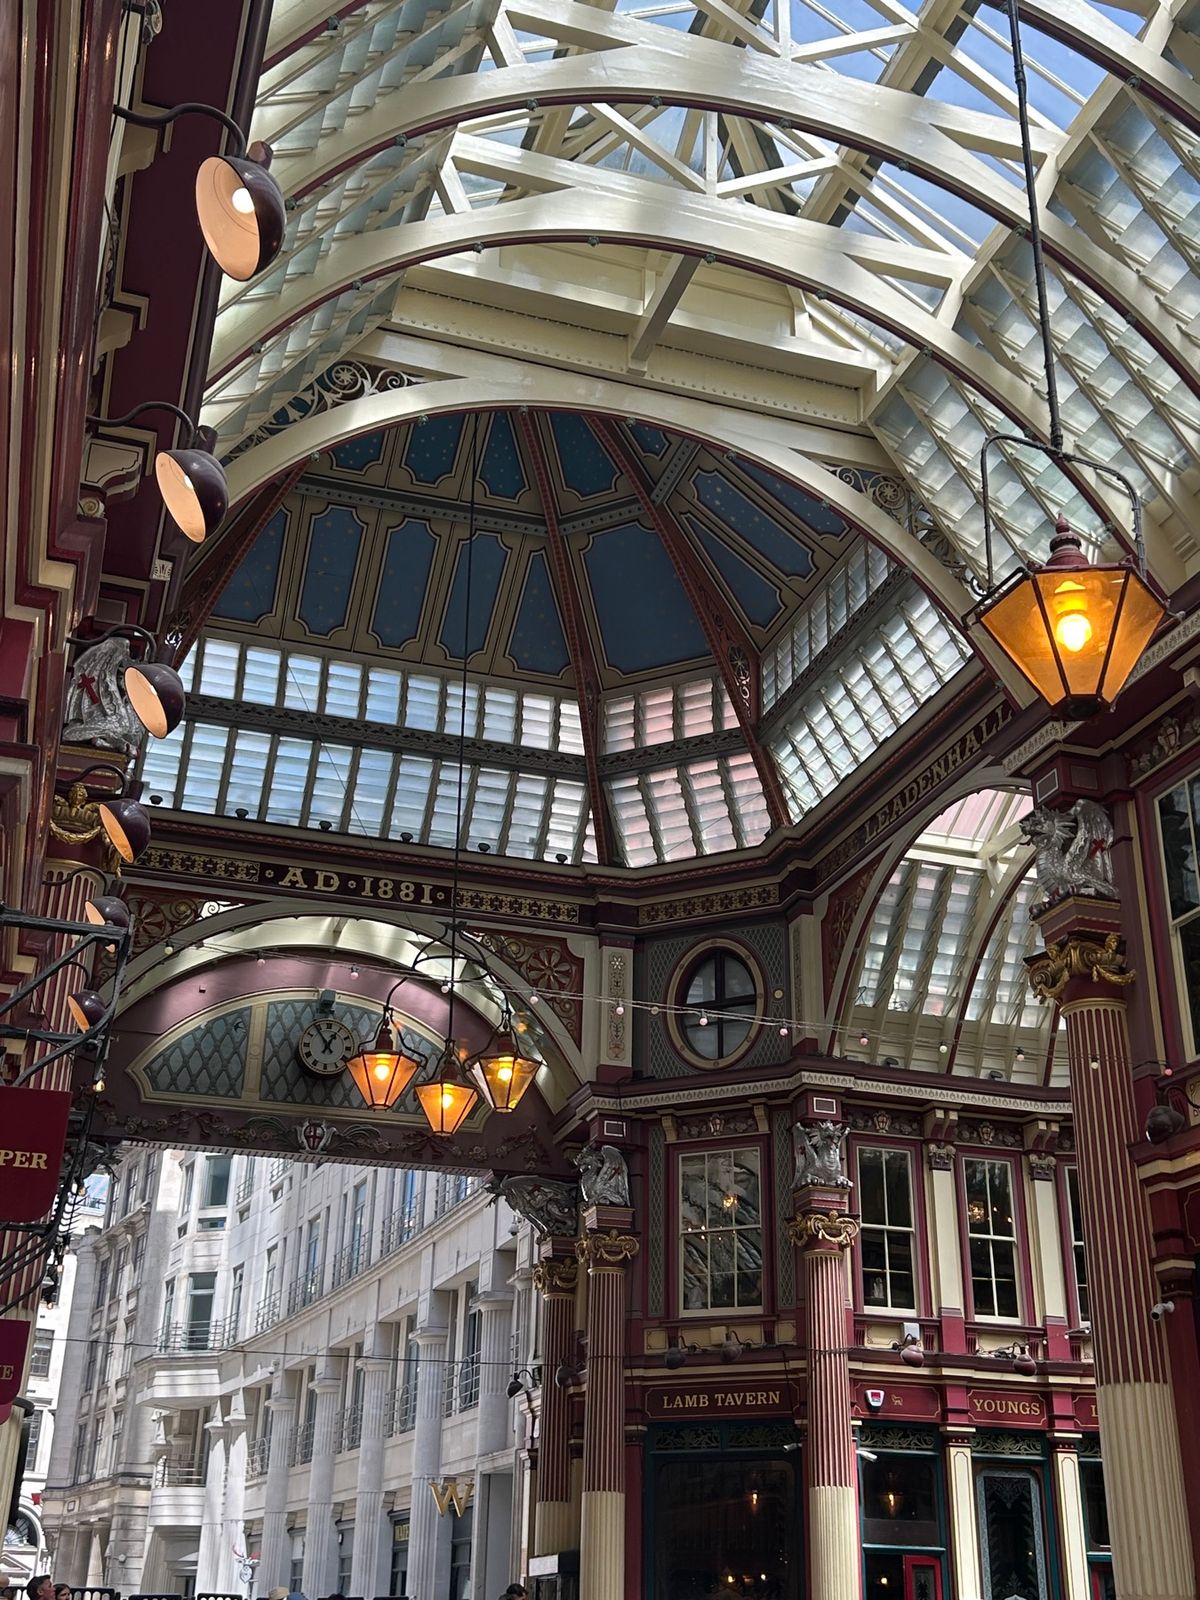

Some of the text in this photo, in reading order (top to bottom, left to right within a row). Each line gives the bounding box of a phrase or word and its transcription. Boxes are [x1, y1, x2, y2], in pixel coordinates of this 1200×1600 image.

[864, 702, 1013, 844] LEADENHALL
[361, 877, 434, 904] 1881
[663, 1391, 781, 1409] LAMB TAVERN
[973, 1399, 1041, 1416] YOUNGS
[428, 1481, 475, 1518] W
